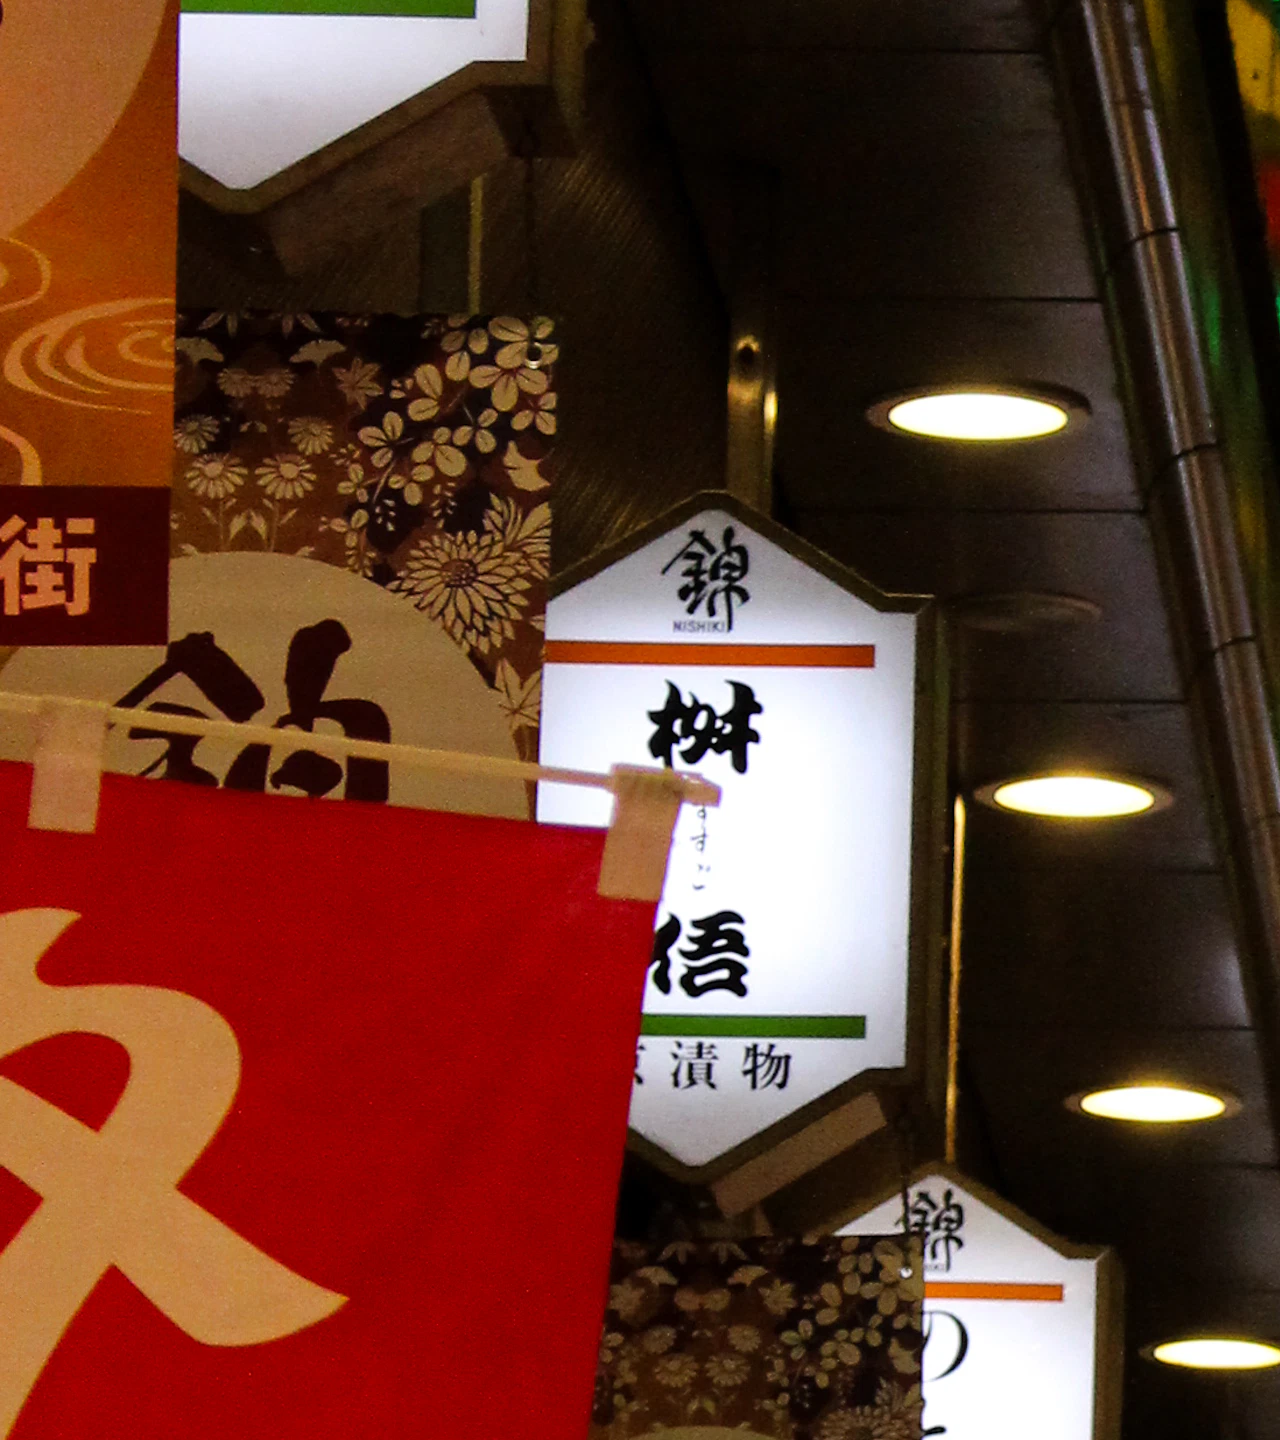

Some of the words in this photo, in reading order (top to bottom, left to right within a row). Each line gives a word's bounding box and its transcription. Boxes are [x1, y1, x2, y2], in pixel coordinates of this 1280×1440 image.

[661, 526, 750, 633] 錦
[672, 621, 728, 633] NISHIKI
[632, 1041, 792, 1090] 漬物
